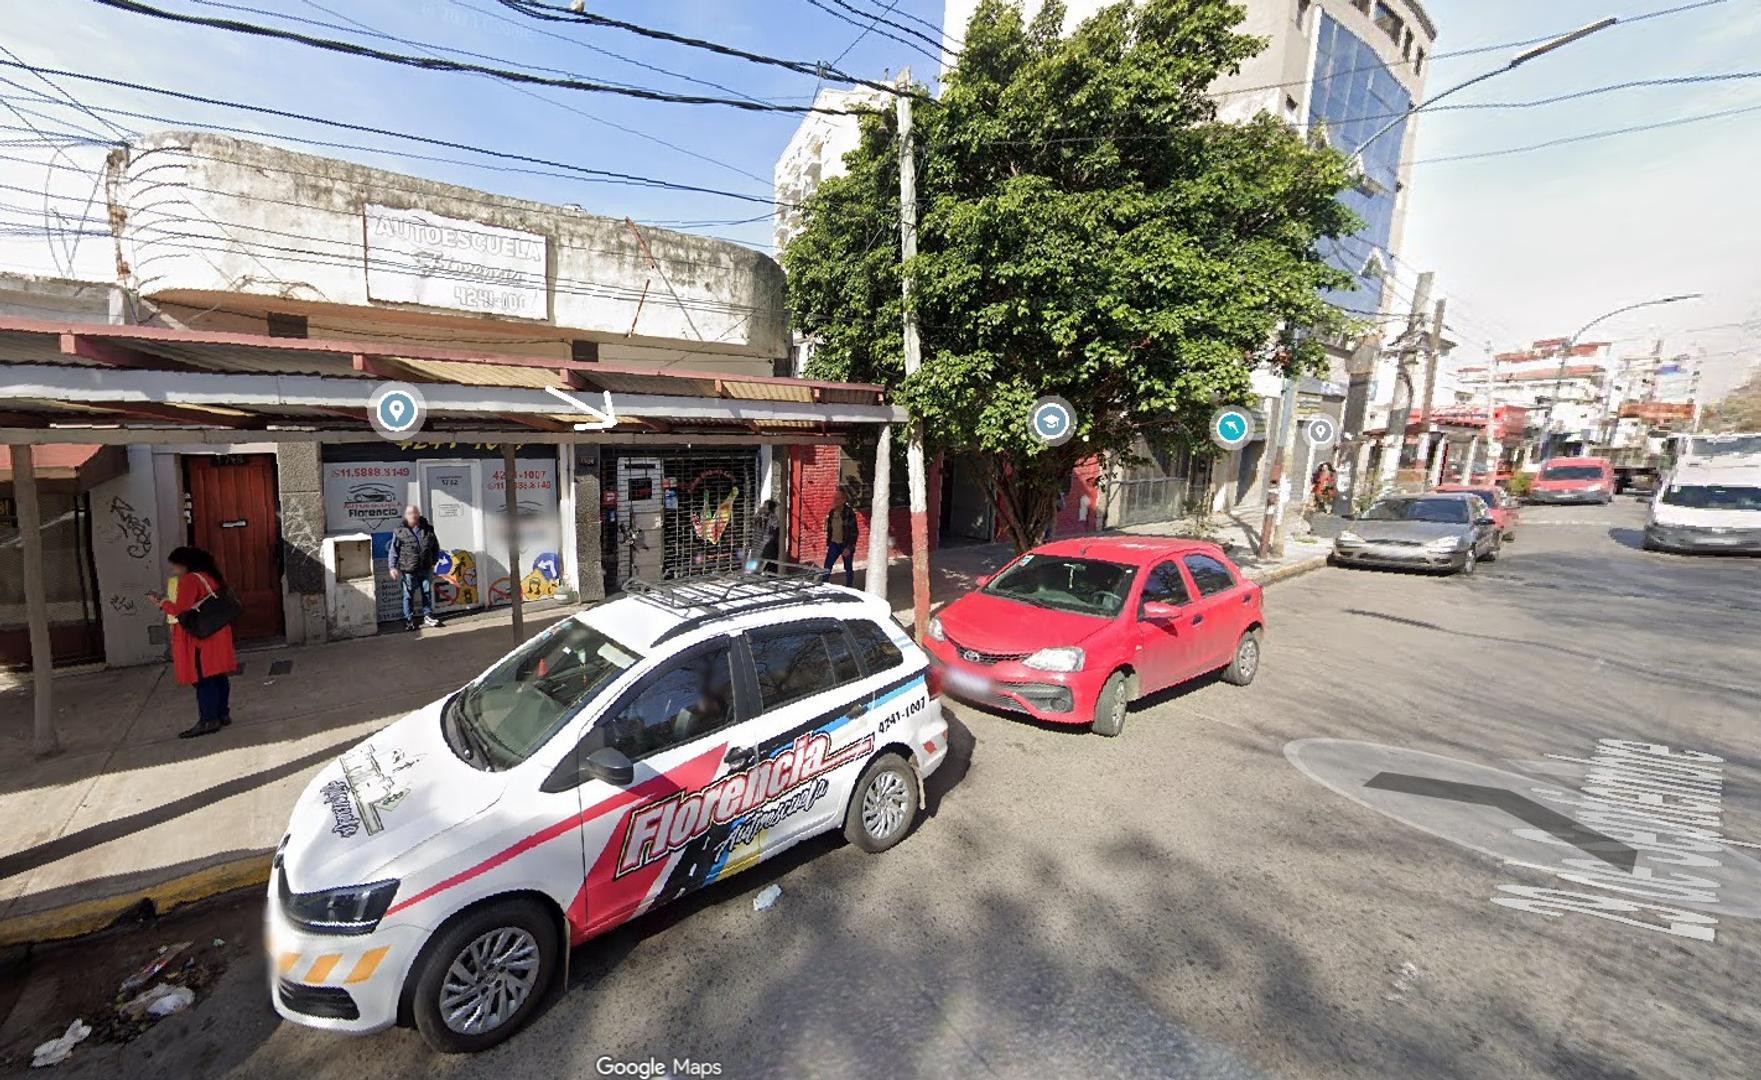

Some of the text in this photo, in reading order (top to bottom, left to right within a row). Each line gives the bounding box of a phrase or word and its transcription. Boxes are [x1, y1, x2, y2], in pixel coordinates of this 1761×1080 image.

[375, 216, 541, 262] AUTOESCUELA
[878, 696, 926, 734] 4241-1007
[614, 731, 833, 881] Florencia
